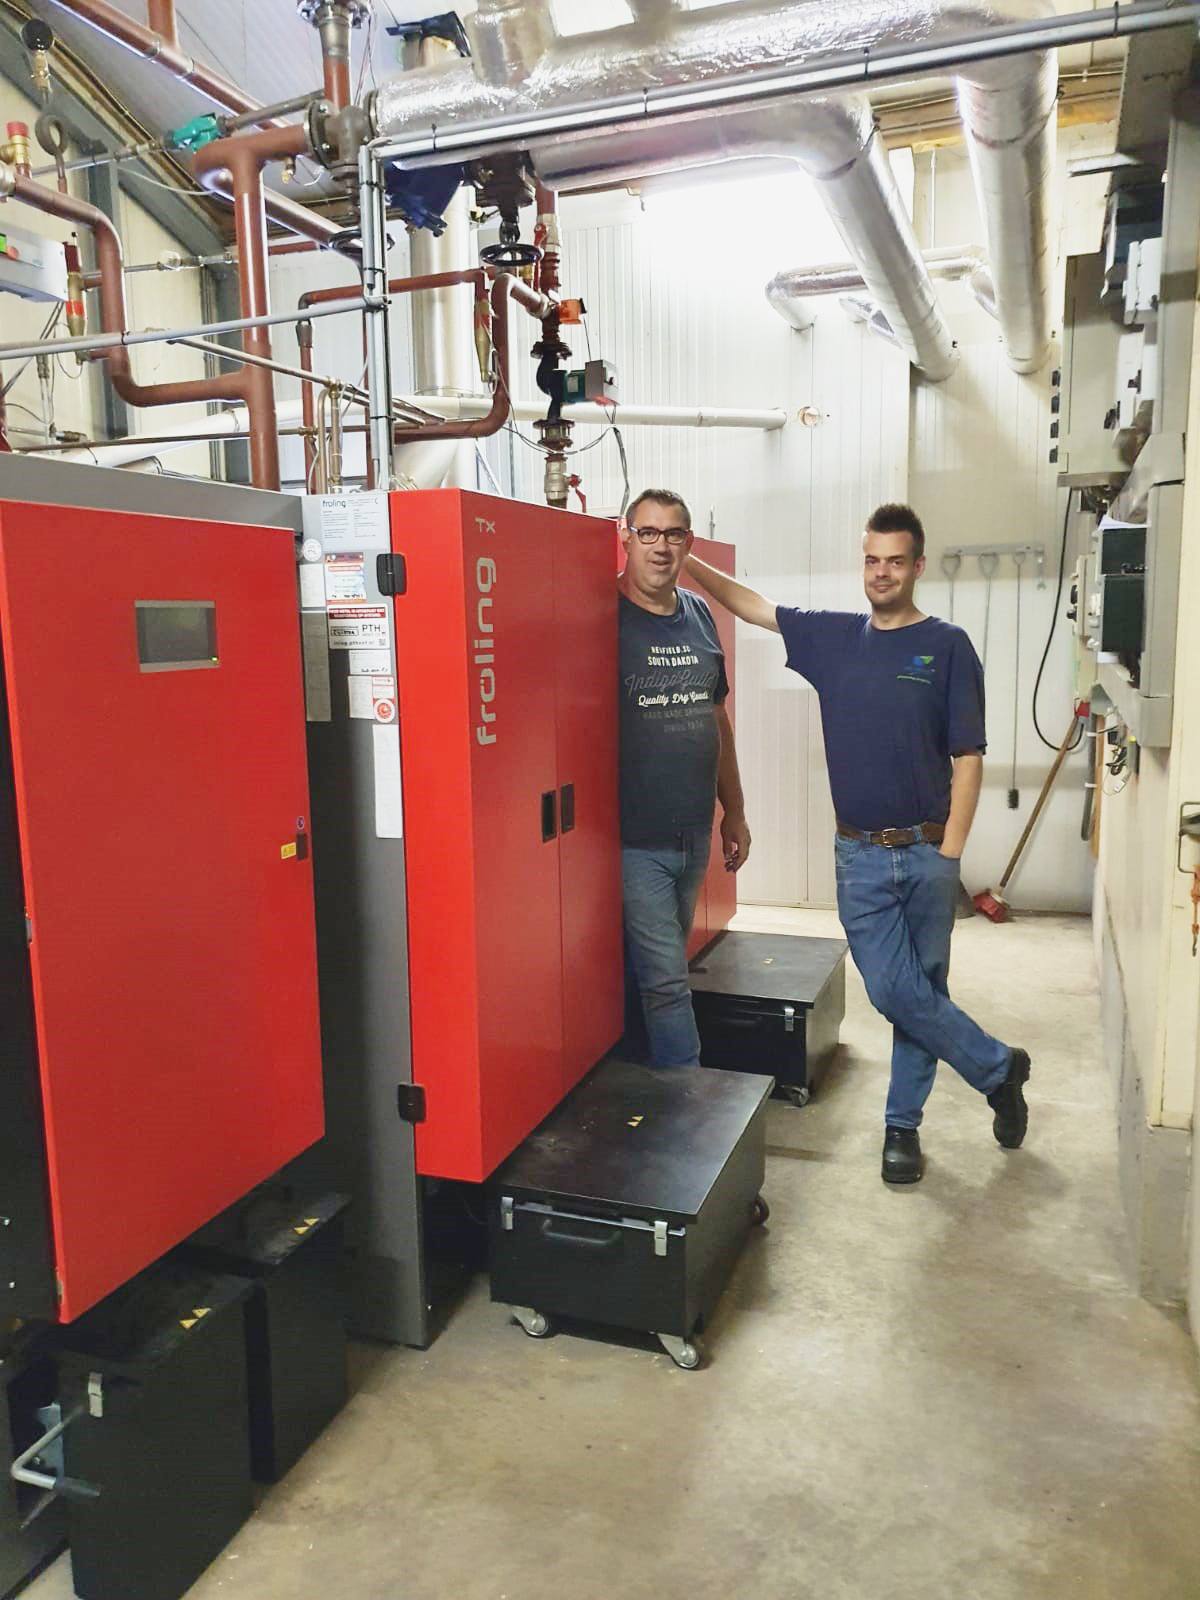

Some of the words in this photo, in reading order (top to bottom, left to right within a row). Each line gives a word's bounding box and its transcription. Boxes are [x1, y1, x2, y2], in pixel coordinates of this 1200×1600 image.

[475, 517, 496, 533] TX
[361, 624, 381, 633] PTH
[648, 656, 671, 667] SOUTH
[671, 655, 699, 667] DAKOTA
[638, 694, 669, 707] Quality
[672, 692, 689, 704] Dry
